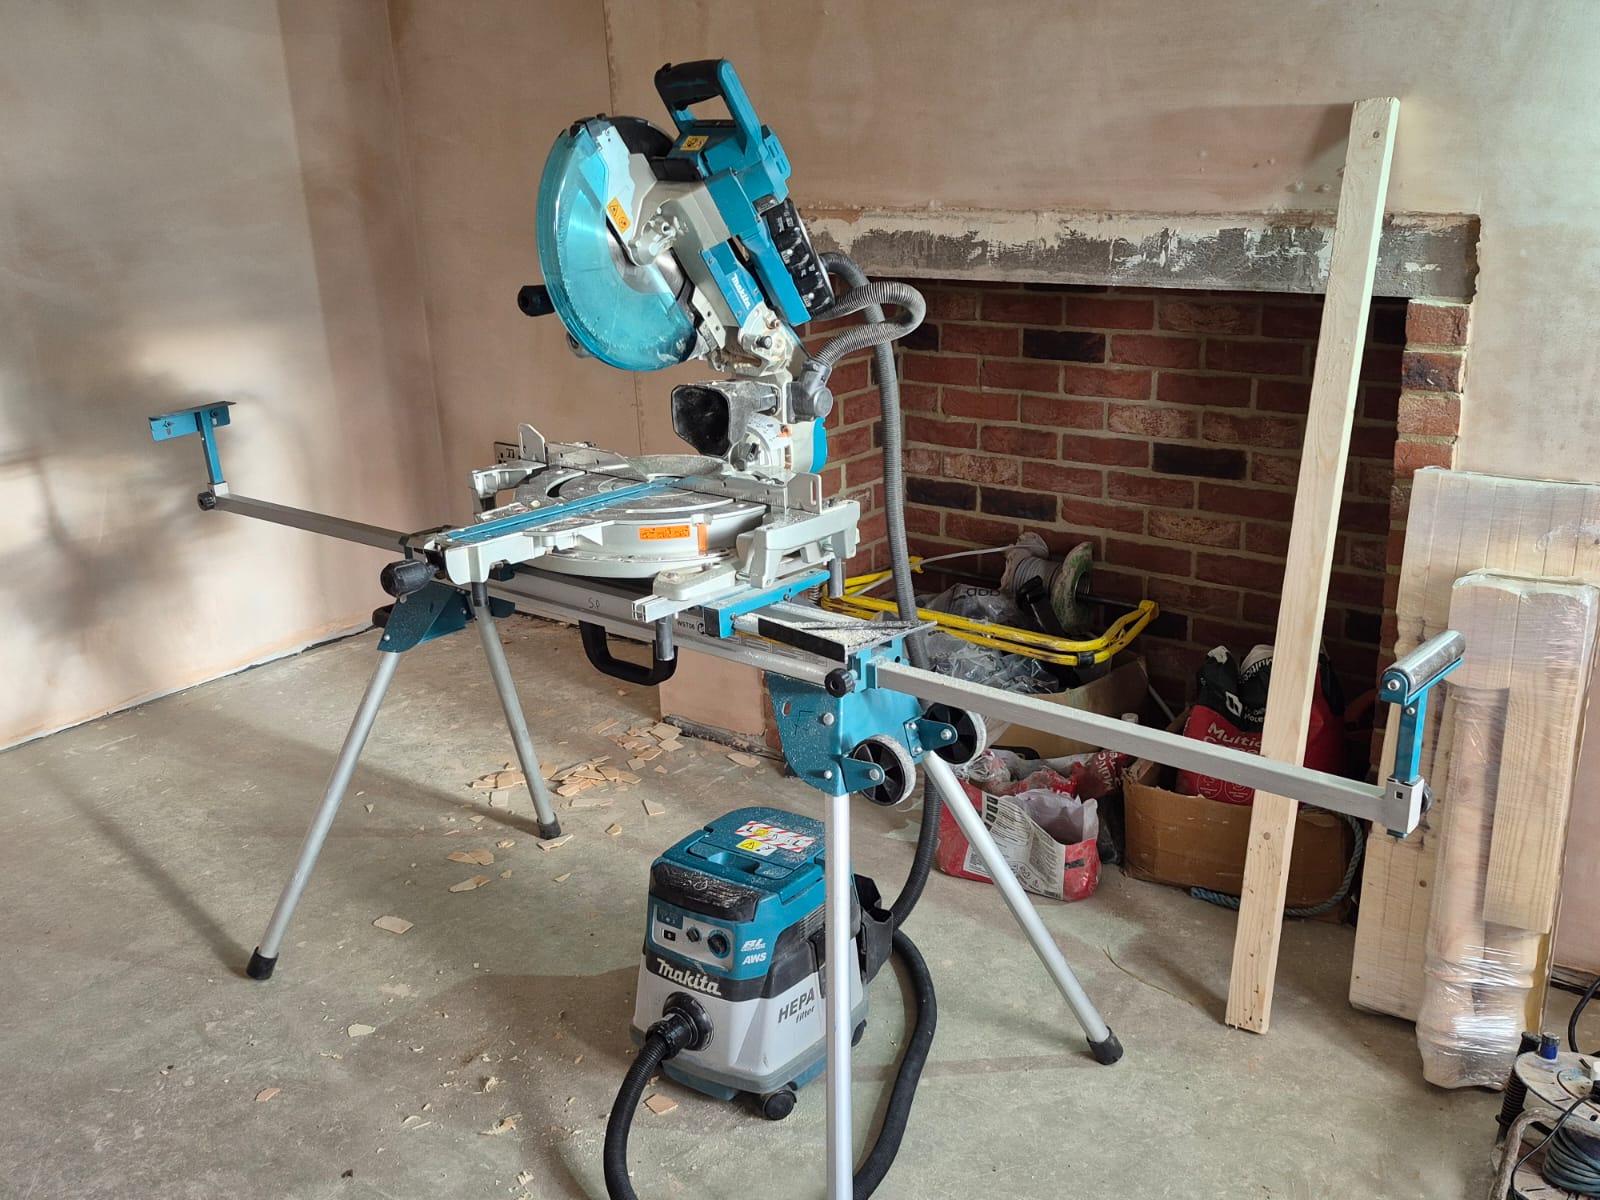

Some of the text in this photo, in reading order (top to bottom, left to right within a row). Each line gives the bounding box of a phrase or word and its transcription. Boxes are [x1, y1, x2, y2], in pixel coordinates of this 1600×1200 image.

[742, 952, 767, 966] AWS
[777, 987, 815, 1023] HEPA
[796, 1005, 815, 1024] filter
